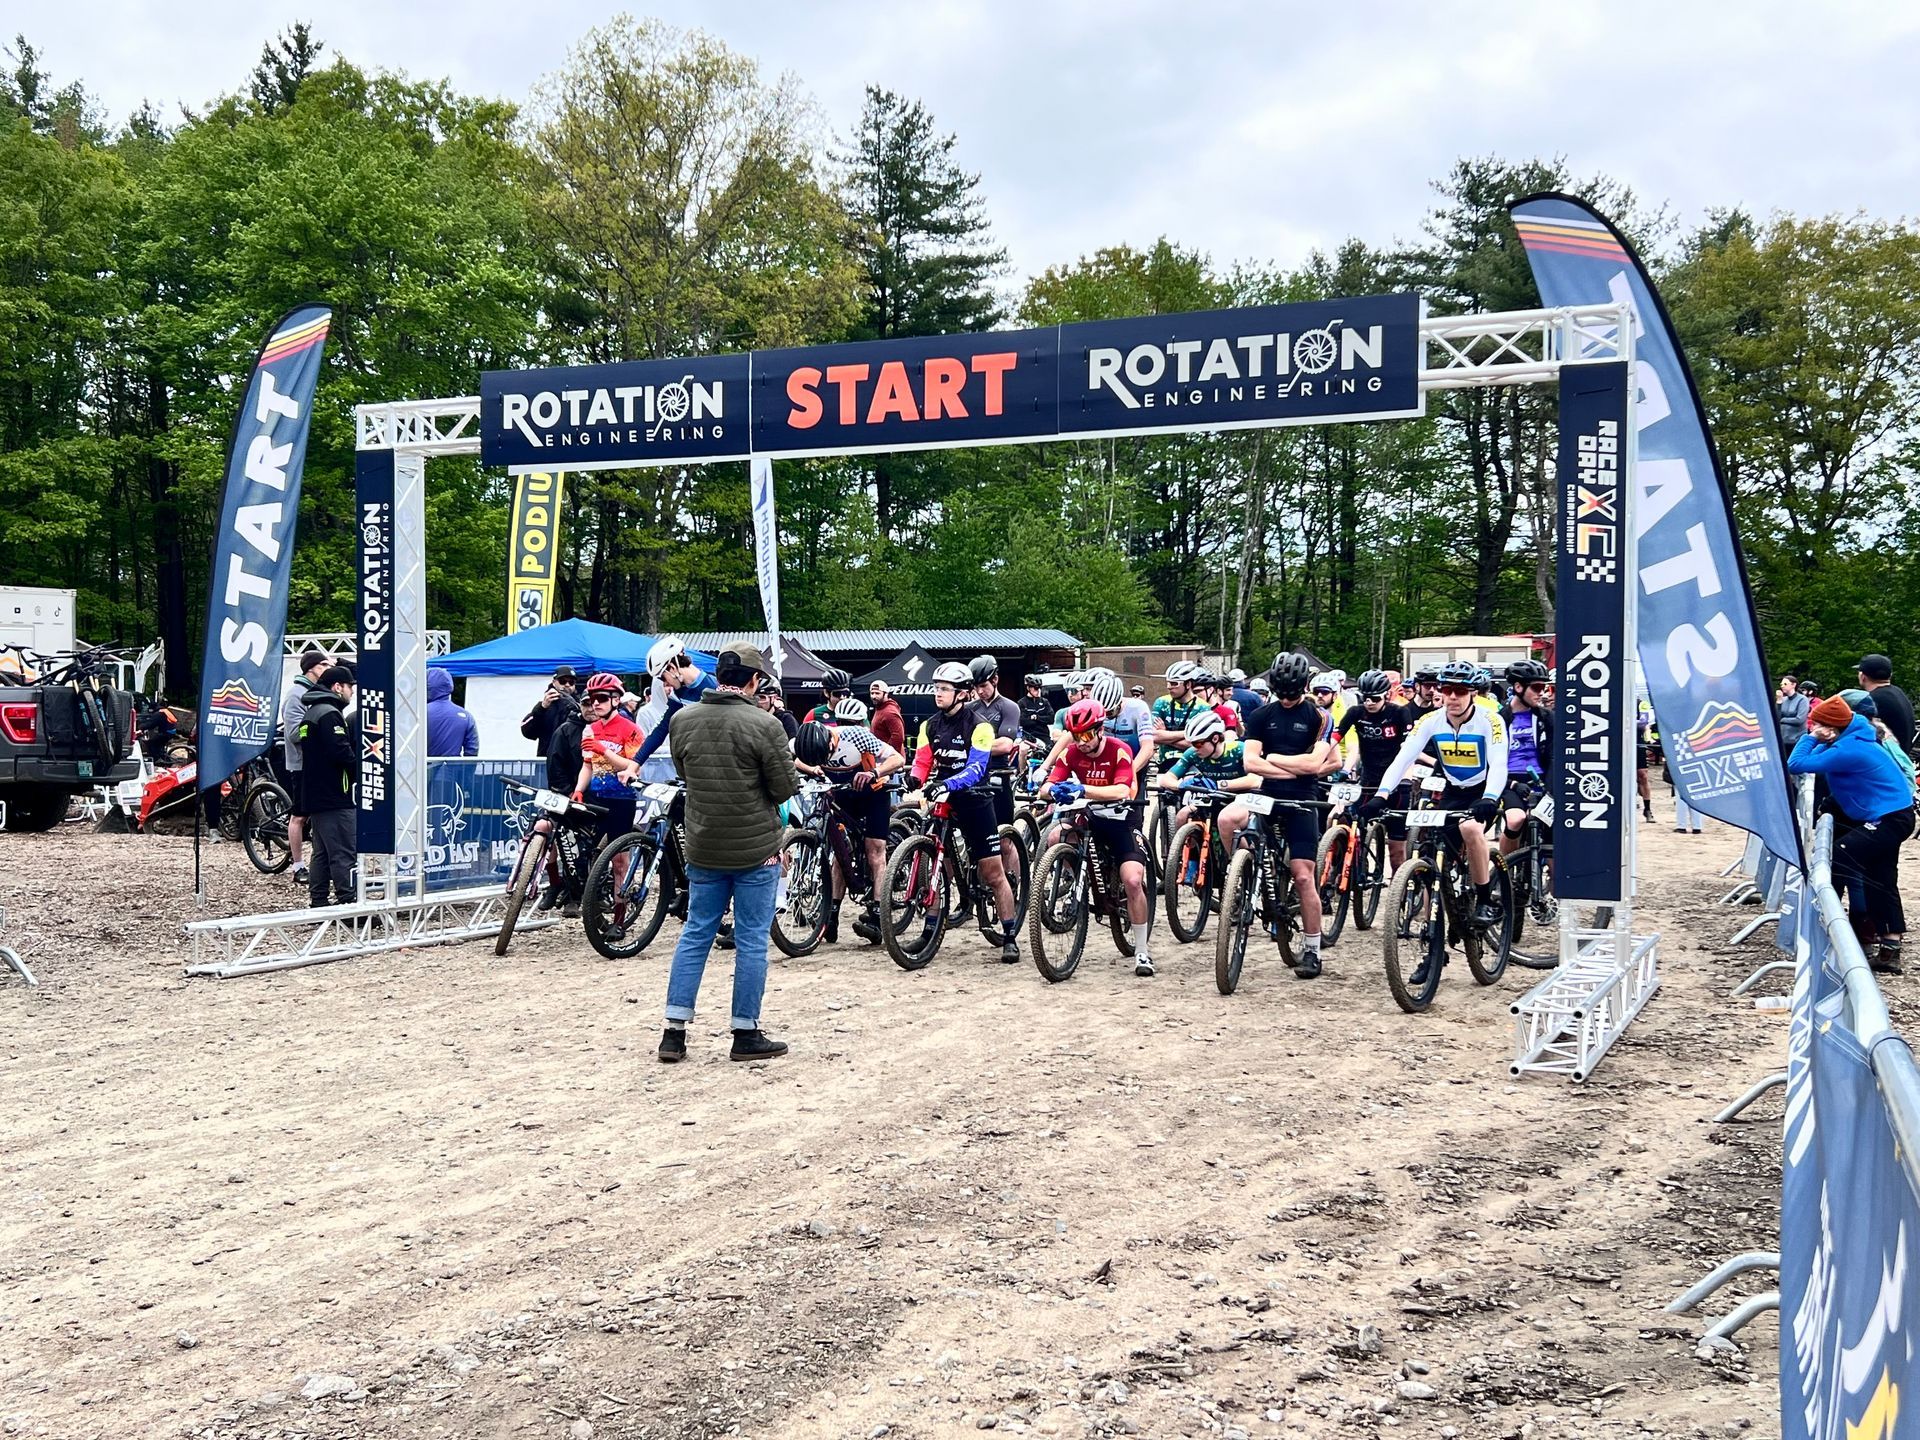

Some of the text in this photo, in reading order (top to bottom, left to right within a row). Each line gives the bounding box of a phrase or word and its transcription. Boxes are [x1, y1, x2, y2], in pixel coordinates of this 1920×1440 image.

[1089, 320, 1382, 408] ROTATION
[503, 375, 723, 447] ROTATION
[786, 352, 1017, 429] START
[1144, 376, 1382, 408] ENGINEERING
[546, 425, 723, 447] ENGINEERING
[1578, 435, 1597, 484] DAY
[1598, 420, 1618, 486] RACE
[220, 370, 299, 667] START
[521, 472, 553, 573] PODIU
[1577, 485, 1617, 557] XC
[361, 503, 390, 650] ROTATION
[888, 684, 937, 695] PECIALIZ
[207, 713, 233, 726] RACE
[213, 725, 232, 737] DAY
[231, 716, 270, 740] XC
[362, 708, 384, 762] XC
[1567, 635, 1615, 830] ROTATION
[1086, 769, 1106, 779] ZERO
[1441, 748, 1477, 758] THXC
[1564, 673, 1577, 828] ENGINEERING
[362, 761, 373, 811] RACE
[373, 763, 384, 800] DAY
[543, 793, 560, 808] 25
[450, 842, 479, 863] FAST
